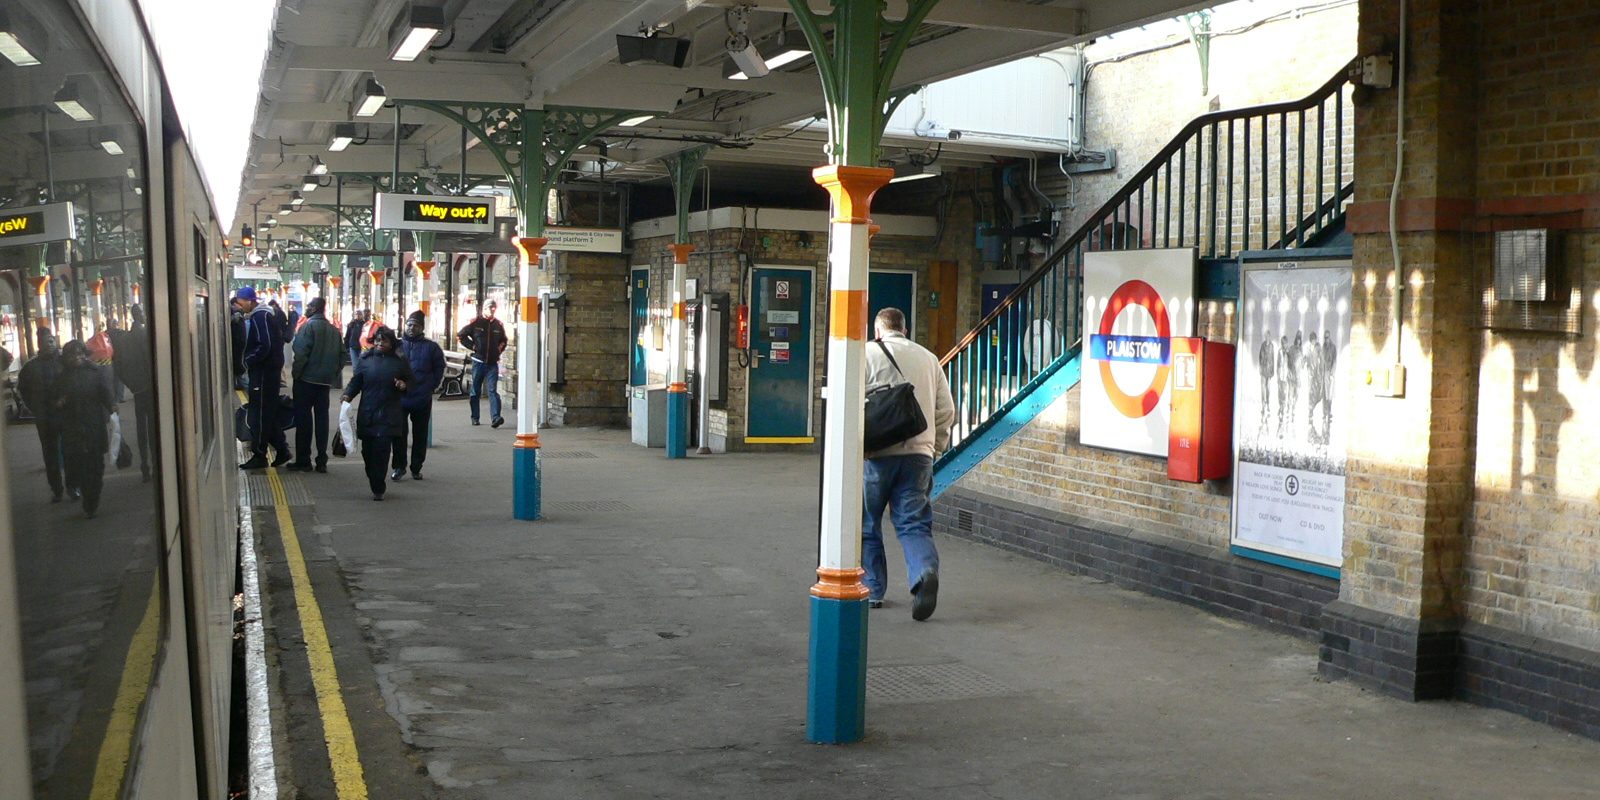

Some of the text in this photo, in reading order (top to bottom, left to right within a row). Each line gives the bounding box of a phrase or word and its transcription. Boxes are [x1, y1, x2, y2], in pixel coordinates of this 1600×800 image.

[420, 204, 474, 219] Way out
[1264, 282, 1339, 300] TAKE THAT
[1107, 340, 1162, 359] PLAISTOW
[1258, 512, 1282, 523] OUT NOW
[1299, 520, 1307, 528] CD
[1313, 522, 1325, 531] DVD
